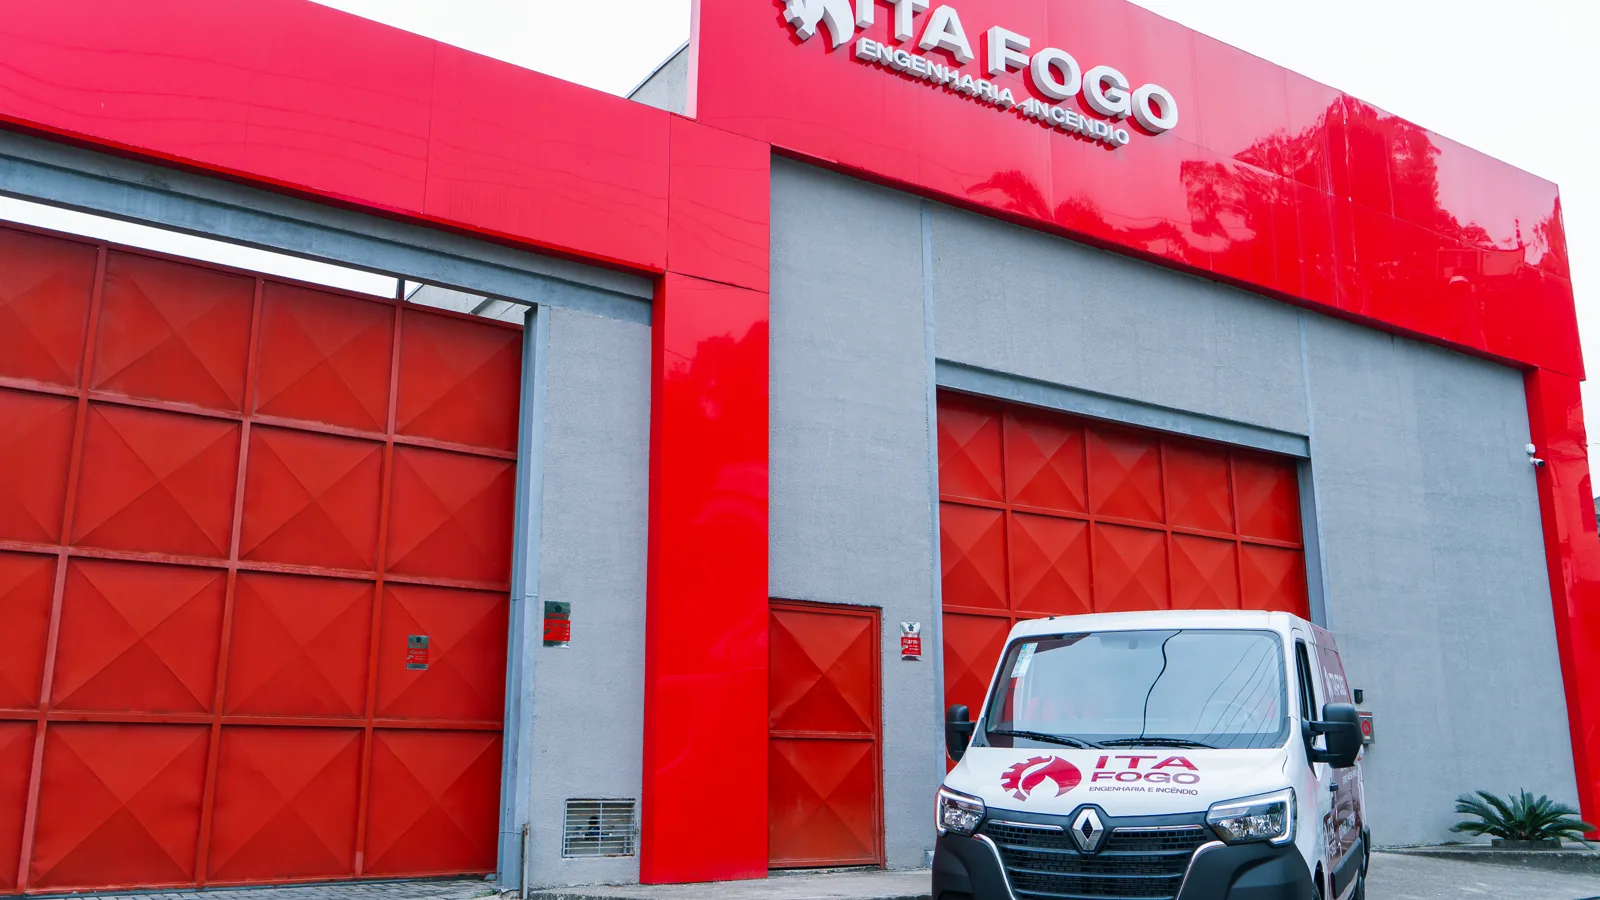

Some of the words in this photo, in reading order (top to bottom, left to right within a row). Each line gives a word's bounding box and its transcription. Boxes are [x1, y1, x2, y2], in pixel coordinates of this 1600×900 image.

[855, 36, 1016, 109] ENGENHARIA
[987, 25, 1179, 133] FOGO
[1095, 755, 1199, 771] ITA
[1091, 771, 1200, 785] FOGO
[1155, 786, 1199, 796] INCÊNDIO
